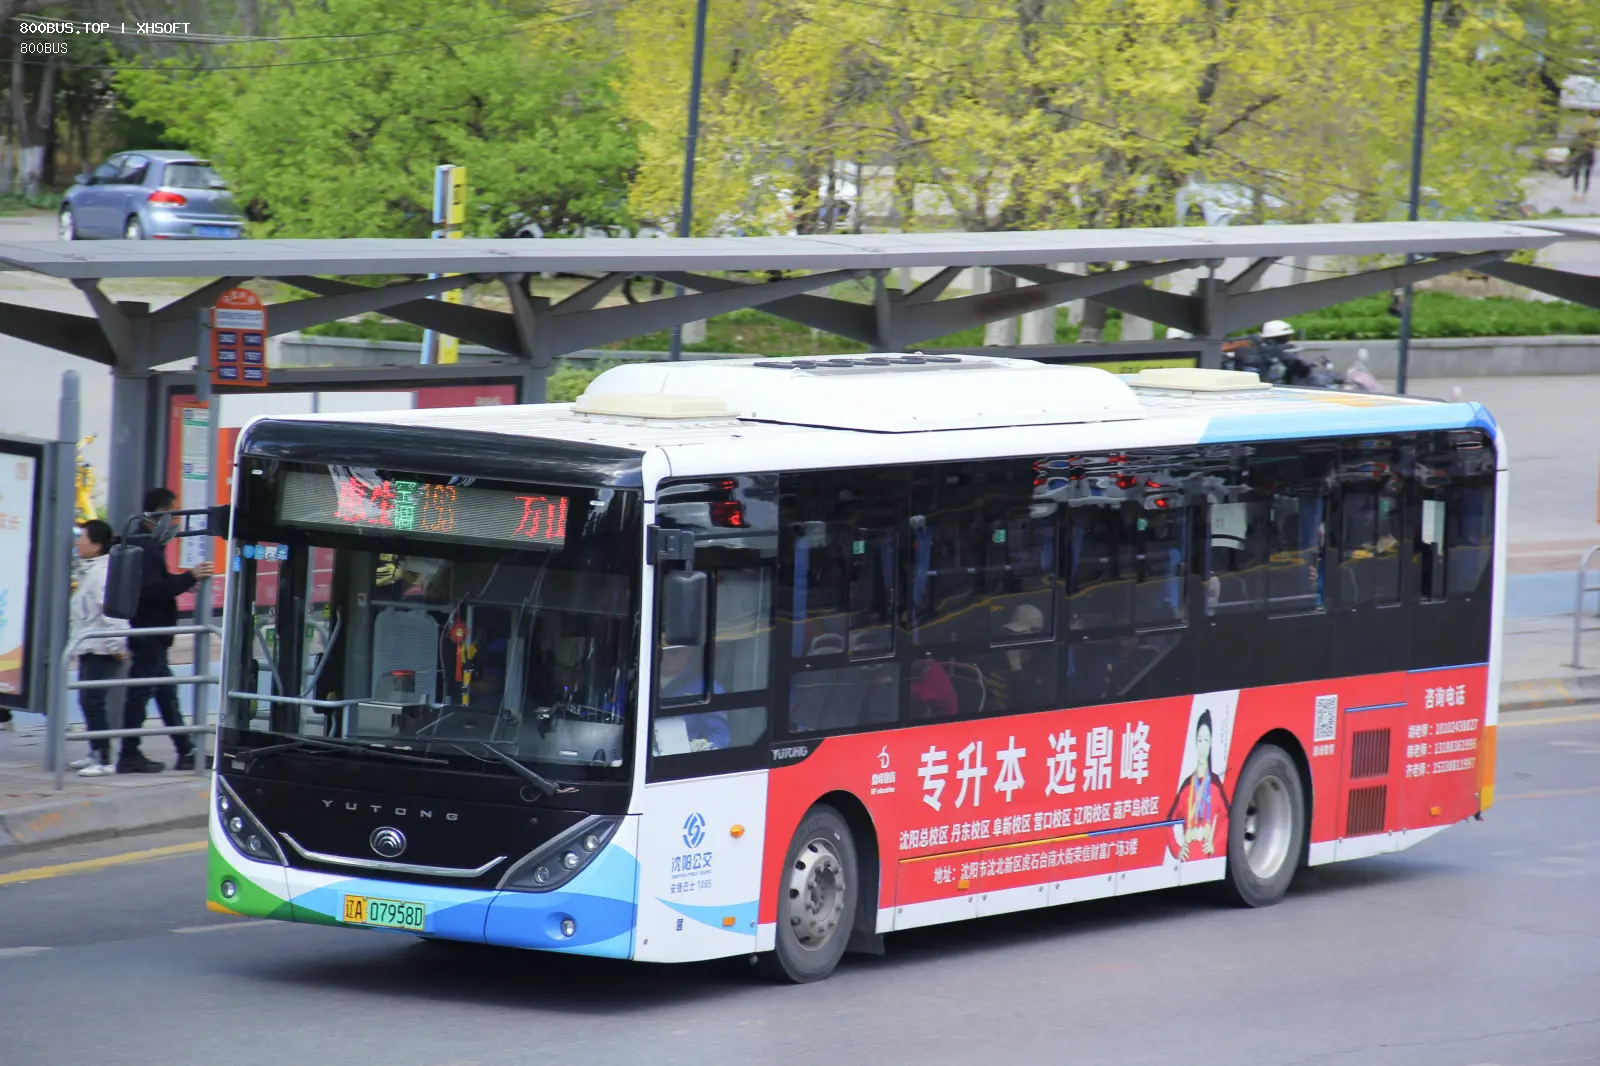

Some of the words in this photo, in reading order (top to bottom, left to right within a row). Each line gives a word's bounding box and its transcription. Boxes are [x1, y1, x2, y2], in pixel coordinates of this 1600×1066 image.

[1425, 685, 1466, 709] 咨询电话
[771, 745, 809, 760] YUTONG
[917, 735, 1027, 812] 专升本
[1045, 720, 1151, 797] 选鼎峰
[322, 799, 459, 821] YUTONG
[899, 825, 949, 850] 沈阳总校区
[951, 819, 991, 843] 丹东校区
[993, 813, 1032, 837] 阜新校区
[1034, 808, 1072, 831] 营口校区
[1073, 802, 1111, 825] 辽阳校区
[1113, 796, 1160, 819] 葫芦岛校区
[671, 852, 713, 872] 沈阳公交
